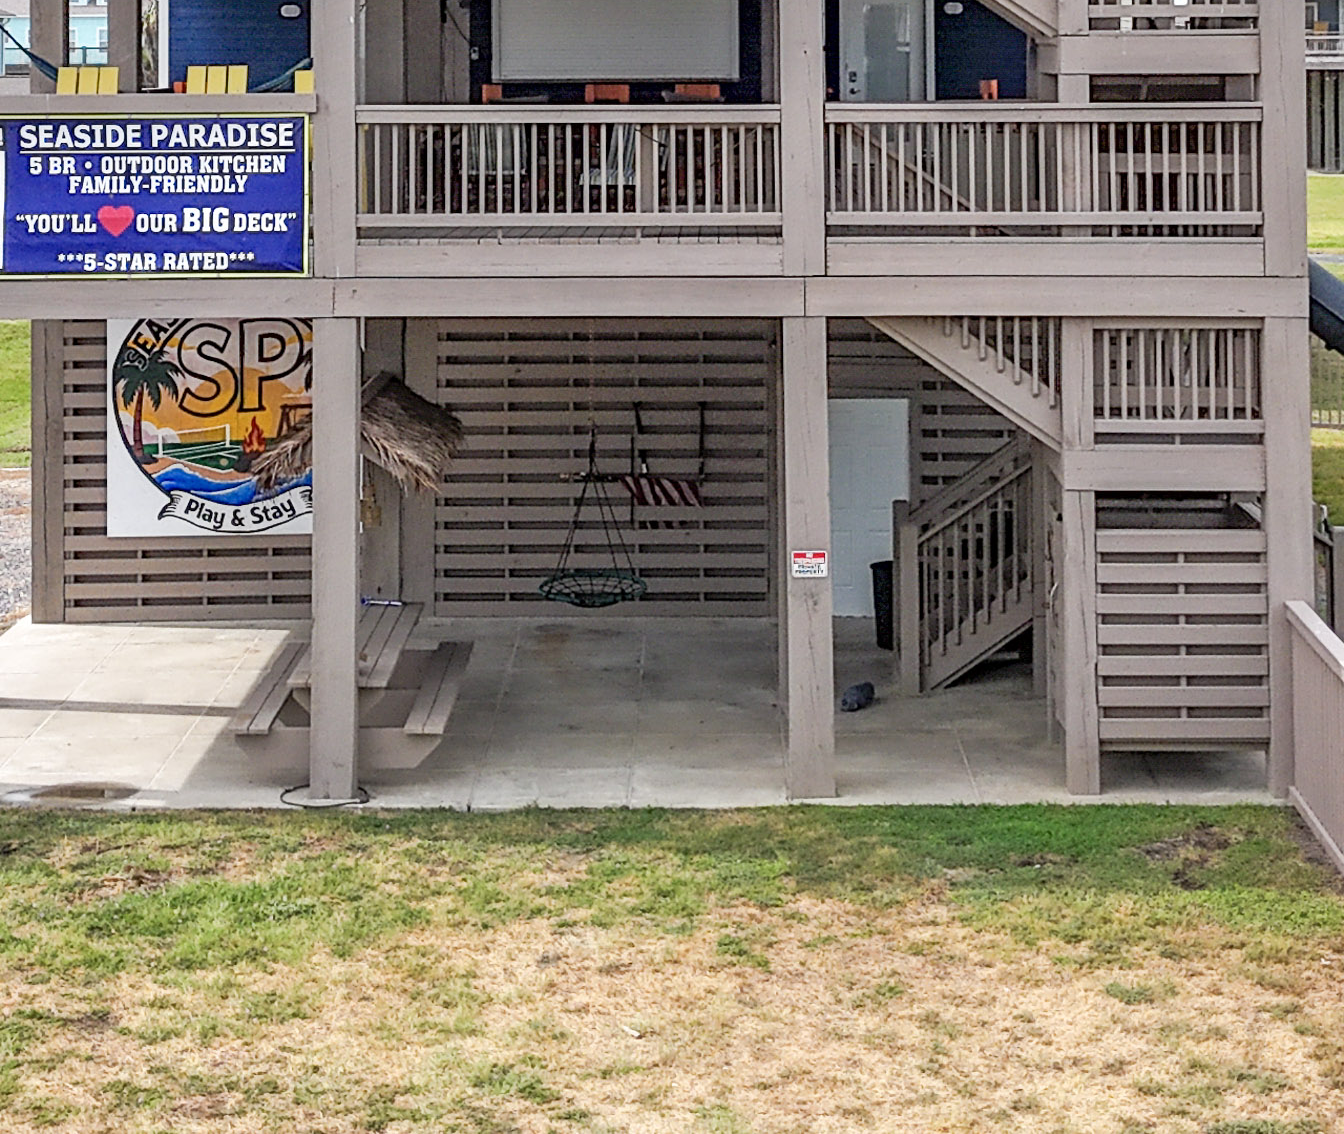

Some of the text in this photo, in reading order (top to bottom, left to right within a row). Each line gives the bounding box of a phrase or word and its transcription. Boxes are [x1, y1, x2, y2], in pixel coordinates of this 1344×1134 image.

[19, 122, 294, 149] SEASIDE PARADISE
[29, 156, 43, 175] 5
[48, 156, 76, 175] BR
[101, 155, 193, 174] OUTDOOR
[198, 154, 287, 173] KITCHEN
[68, 174, 249, 194] FAMILY-FRIENDLY
[15, 207, 297, 233] “YOU’LL OUR BIG DECK”
[122, 318, 180, 372] SEA
[177, 318, 303, 418] SP
[184, 498, 297, 529] Play & Stay
